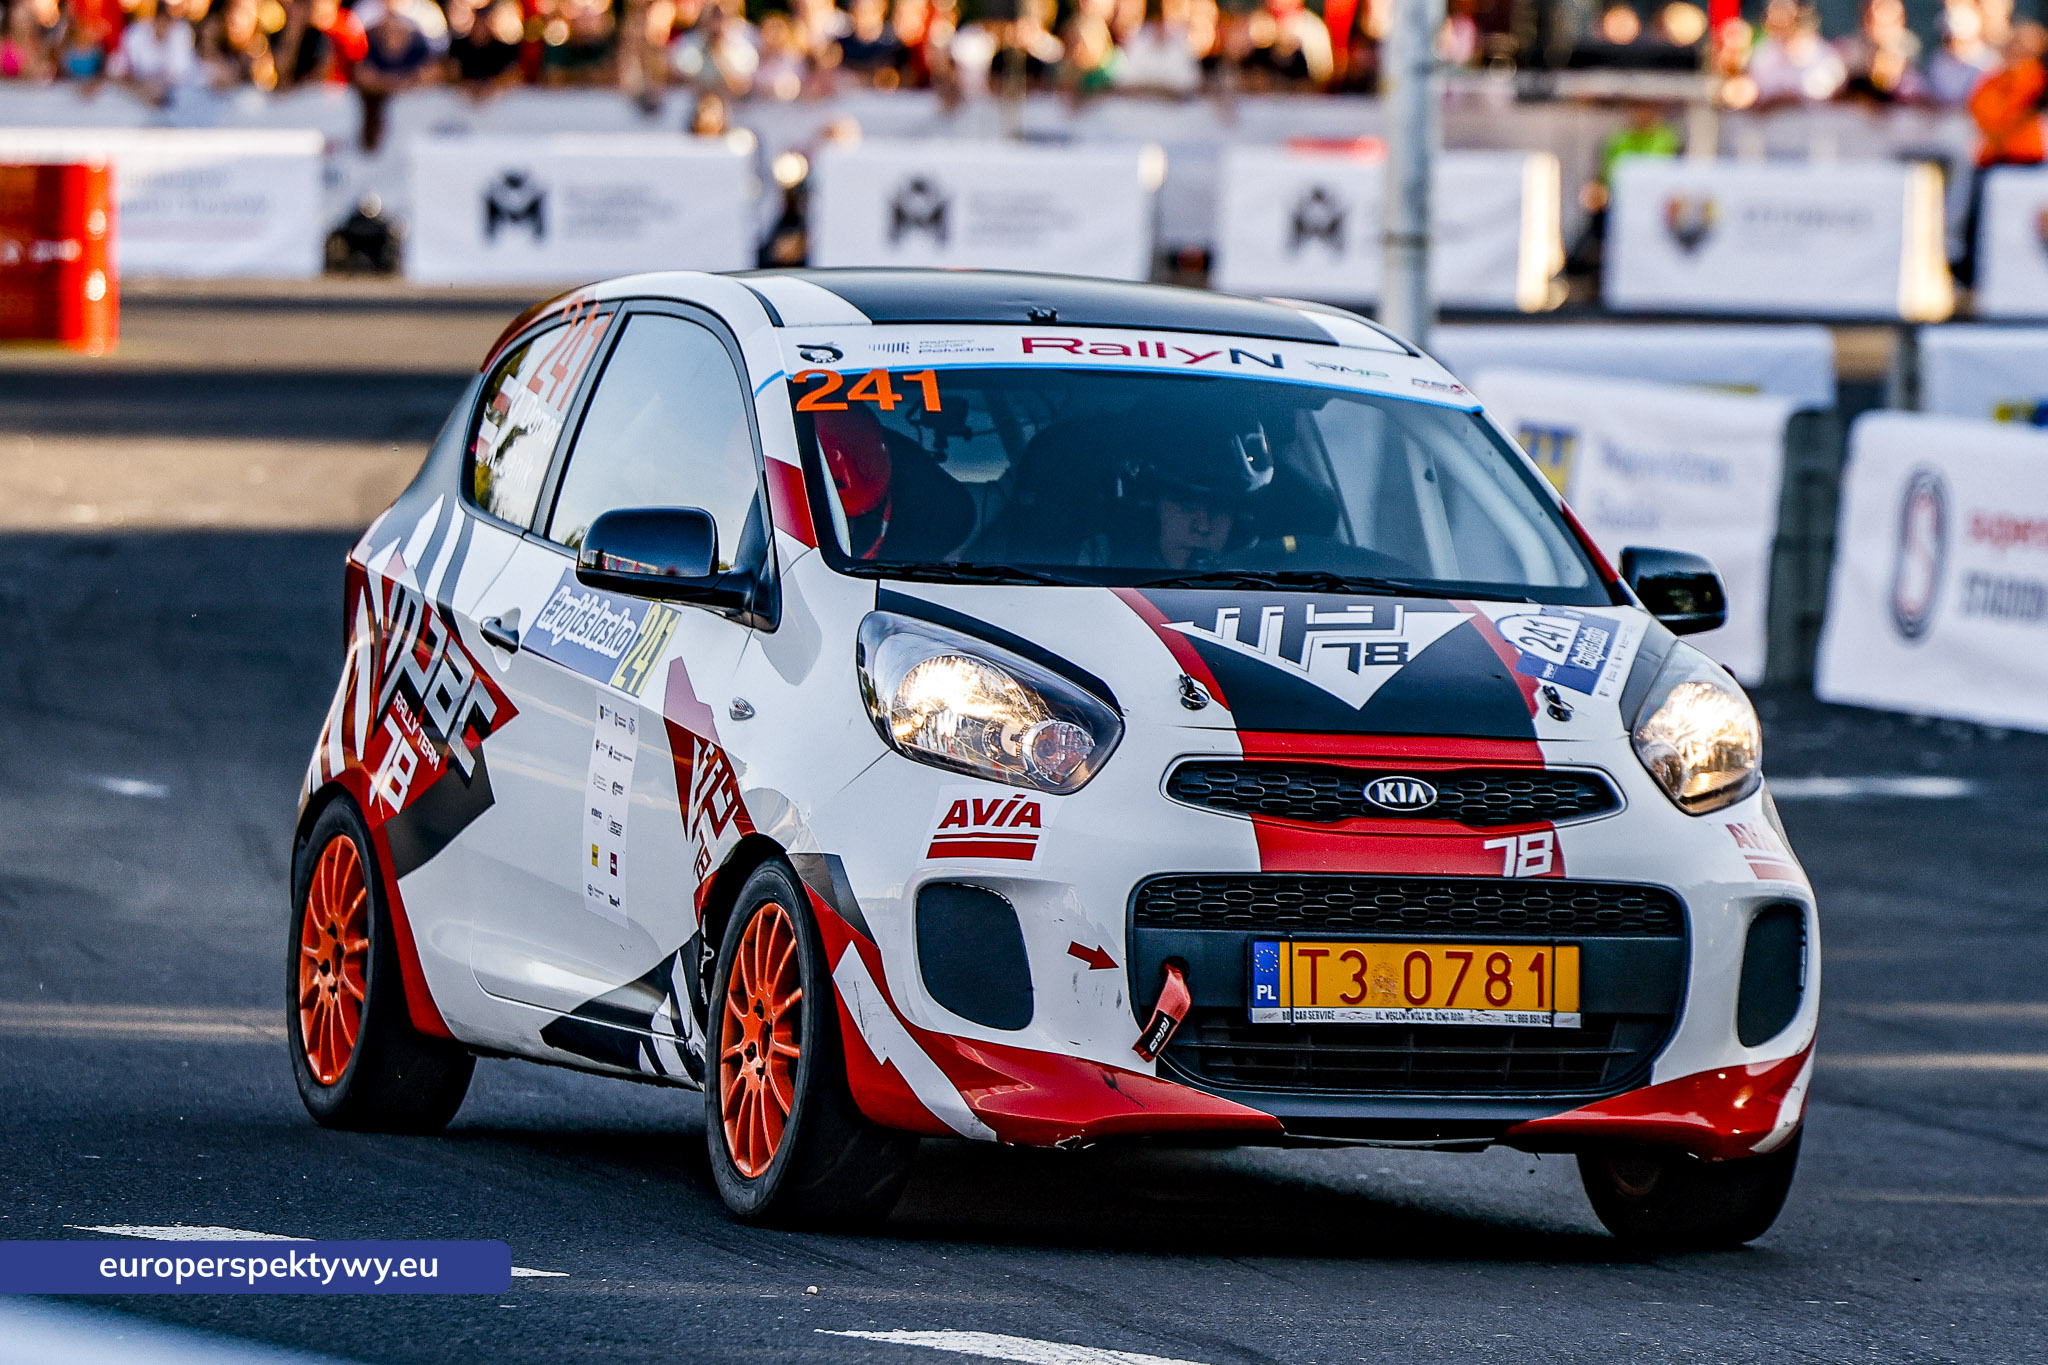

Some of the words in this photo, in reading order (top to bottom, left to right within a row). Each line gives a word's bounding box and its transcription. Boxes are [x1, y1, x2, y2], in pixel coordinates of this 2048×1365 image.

[1021, 336, 1284, 370] RallyN
[792, 368, 942, 412] 241
[538, 587, 636, 656] #rajdslaska
[1518, 618, 1572, 653] 241
[611, 603, 682, 698] 241
[1322, 641, 1409, 675] 78
[392, 689, 421, 737] RALLY
[416, 723, 441, 772] TEAM
[369, 713, 419, 815] 78
[1376, 782, 1428, 804] KIA
[1484, 830, 1554, 878] 78
[1257, 984, 1277, 1000] PL
[1297, 948, 1368, 1006] T3
[1403, 949, 1546, 1008] 0781
[1308, 1010, 1336, 1021] SERVICE
